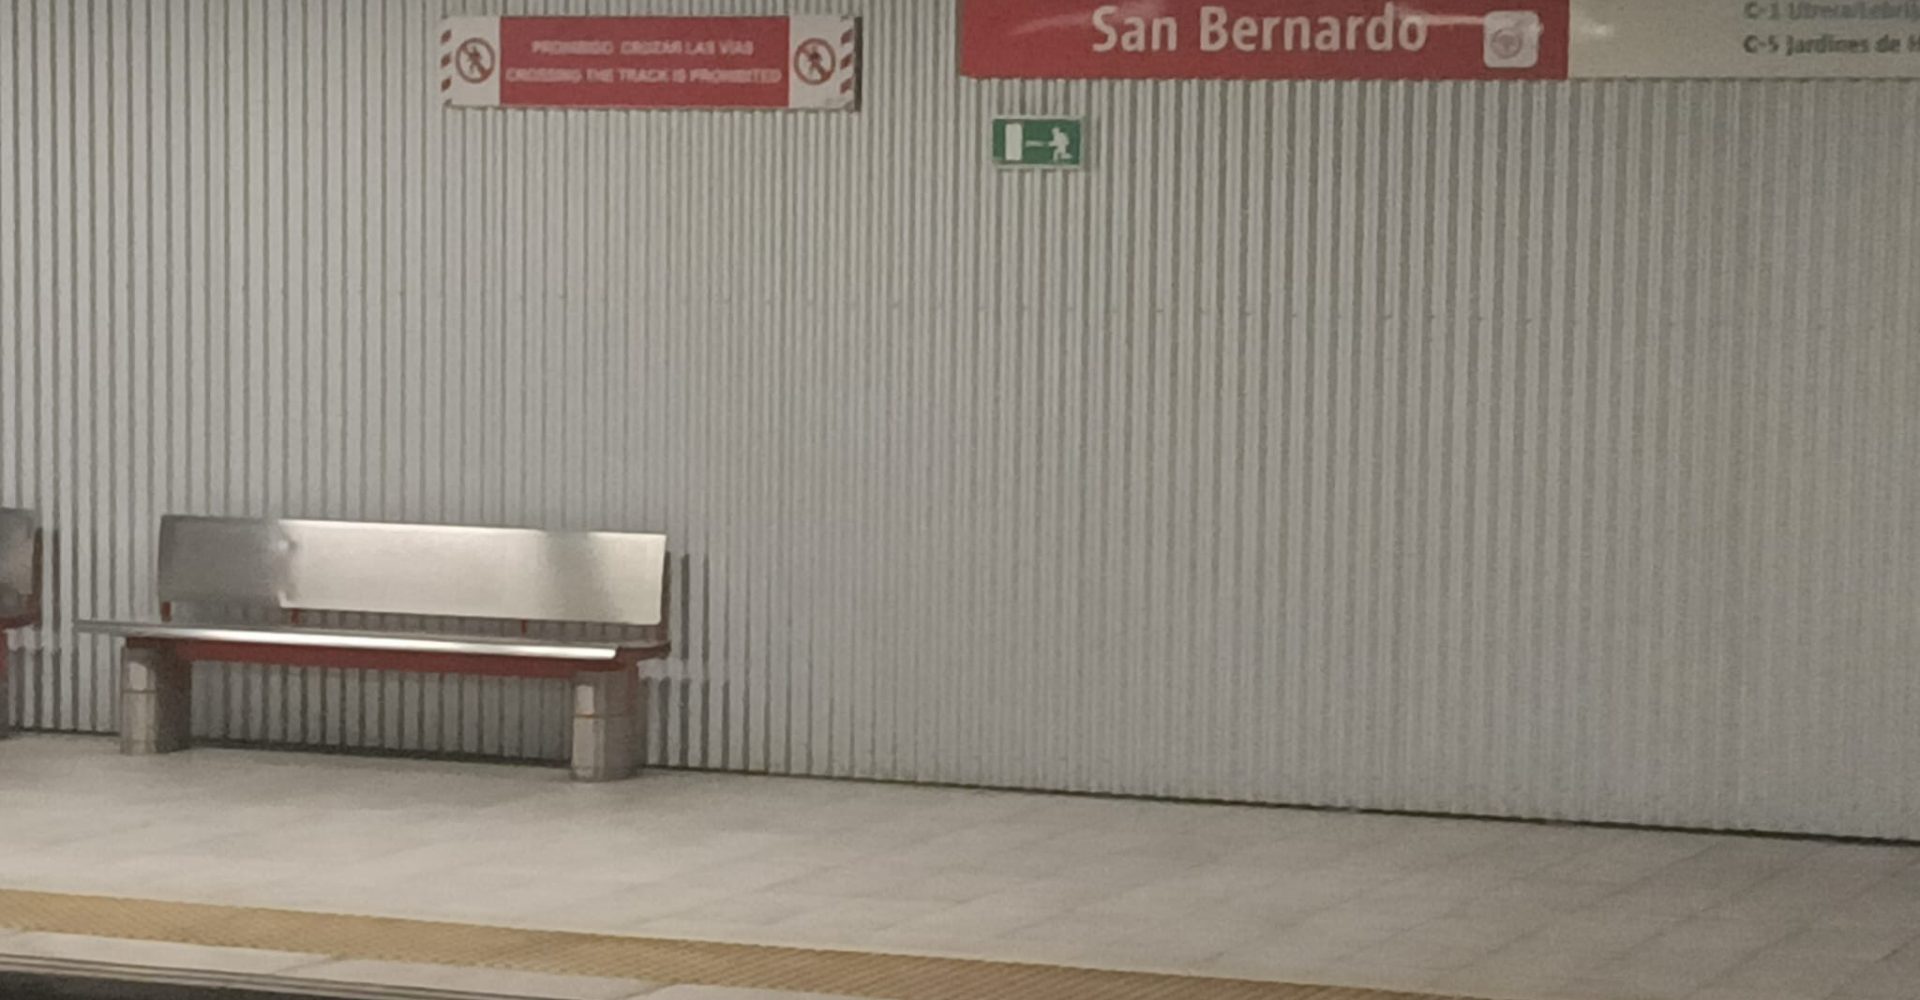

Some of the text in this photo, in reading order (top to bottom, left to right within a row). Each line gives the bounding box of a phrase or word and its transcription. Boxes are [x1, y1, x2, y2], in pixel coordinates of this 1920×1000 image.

[1743, 1, 1780, 20] C-1
[1091, 2, 1427, 53] San Bernardo
[620, 40, 682, 55] CRUZAR
[684, 40, 715, 55] LAS
[1742, 35, 1780, 53] C-5
[1786, 34, 1870, 56] Jardines
[1875, 34, 1901, 53] de
[505, 67, 782, 84] CROSSING THE TRACK IS PROHIBITED
